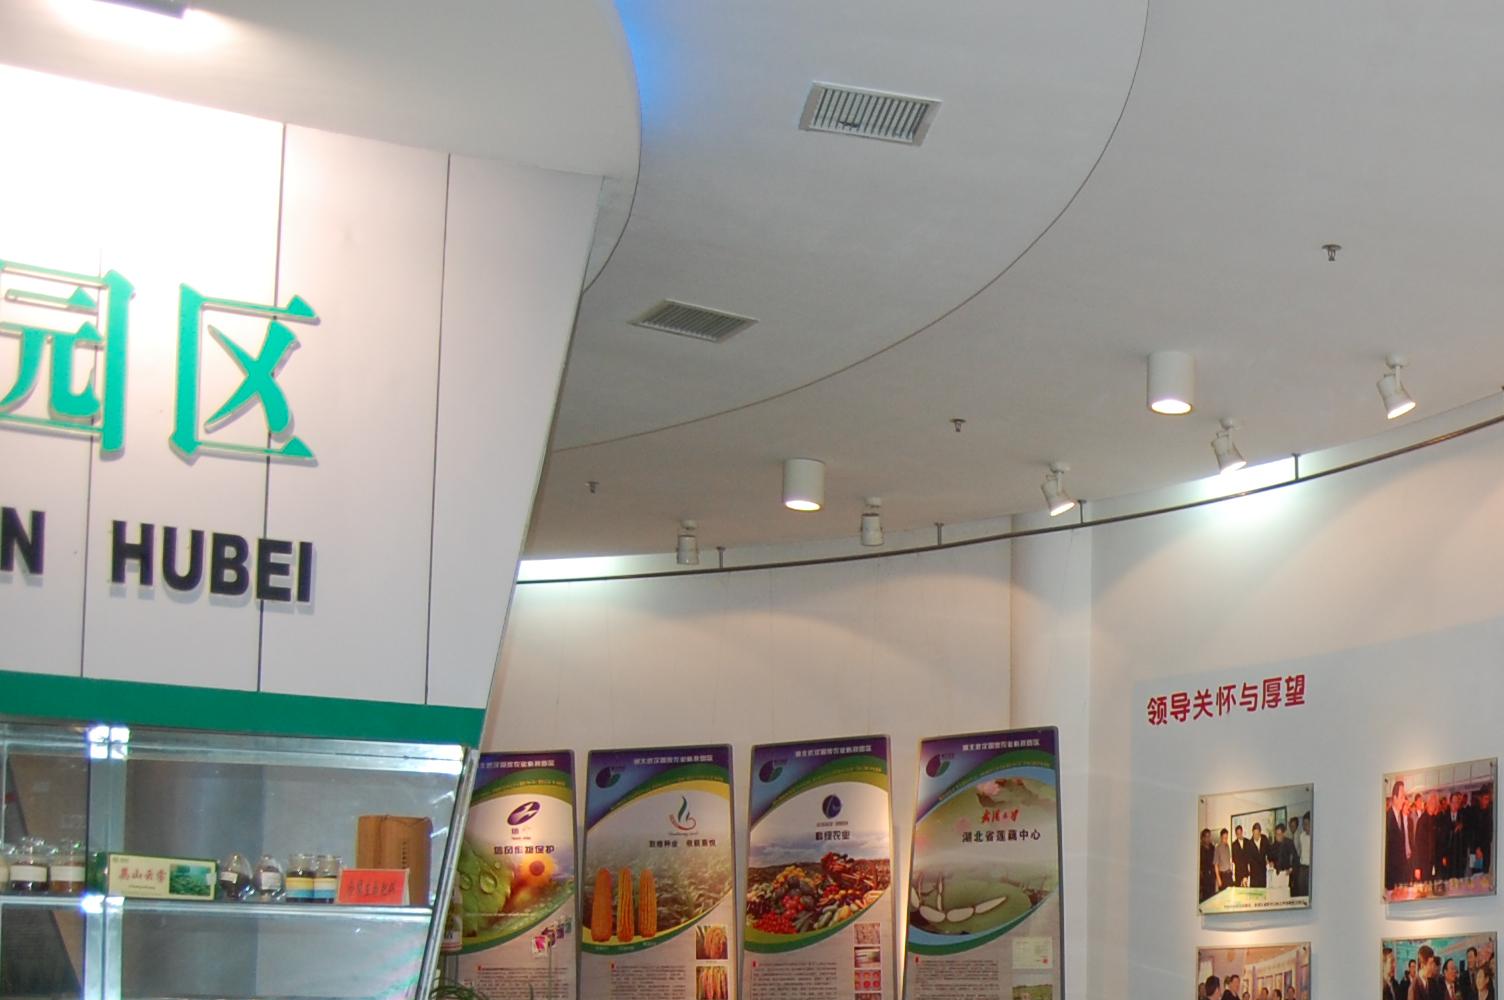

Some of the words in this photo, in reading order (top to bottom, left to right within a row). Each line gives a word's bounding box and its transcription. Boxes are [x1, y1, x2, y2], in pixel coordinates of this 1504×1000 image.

[0, 258, 320, 465] 园区
[111, 518, 315, 604] HUBEI
[1147, 674, 1306, 726] 领导关怀与厚望
